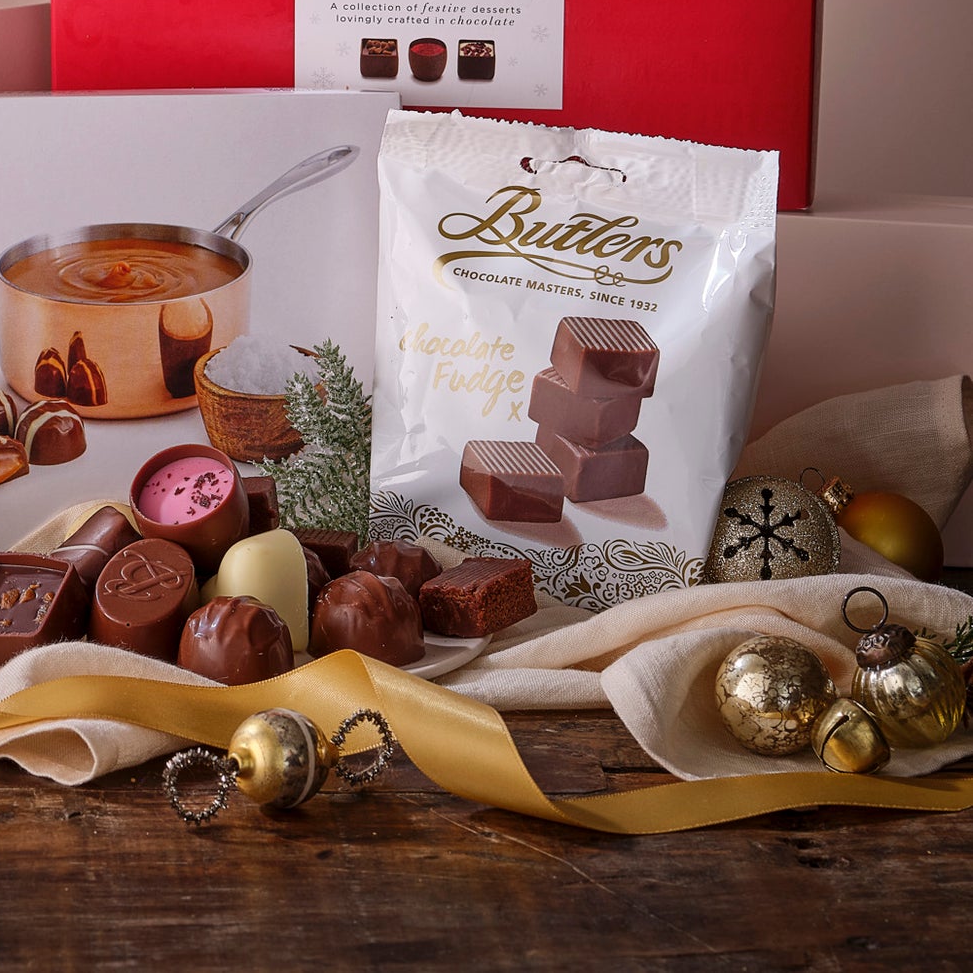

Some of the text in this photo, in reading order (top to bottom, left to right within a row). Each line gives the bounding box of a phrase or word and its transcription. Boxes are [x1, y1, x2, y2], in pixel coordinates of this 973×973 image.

[330, 3, 522, 15] A collection of festive desserts
[336, 15, 515, 27] lovingly crafted in chocolate
[437, 185, 683, 277] Butlers
[453, 267, 658, 313] CHOCOLATE MASTERS, SINCE 1932
[433, 361, 525, 417] Fudge
